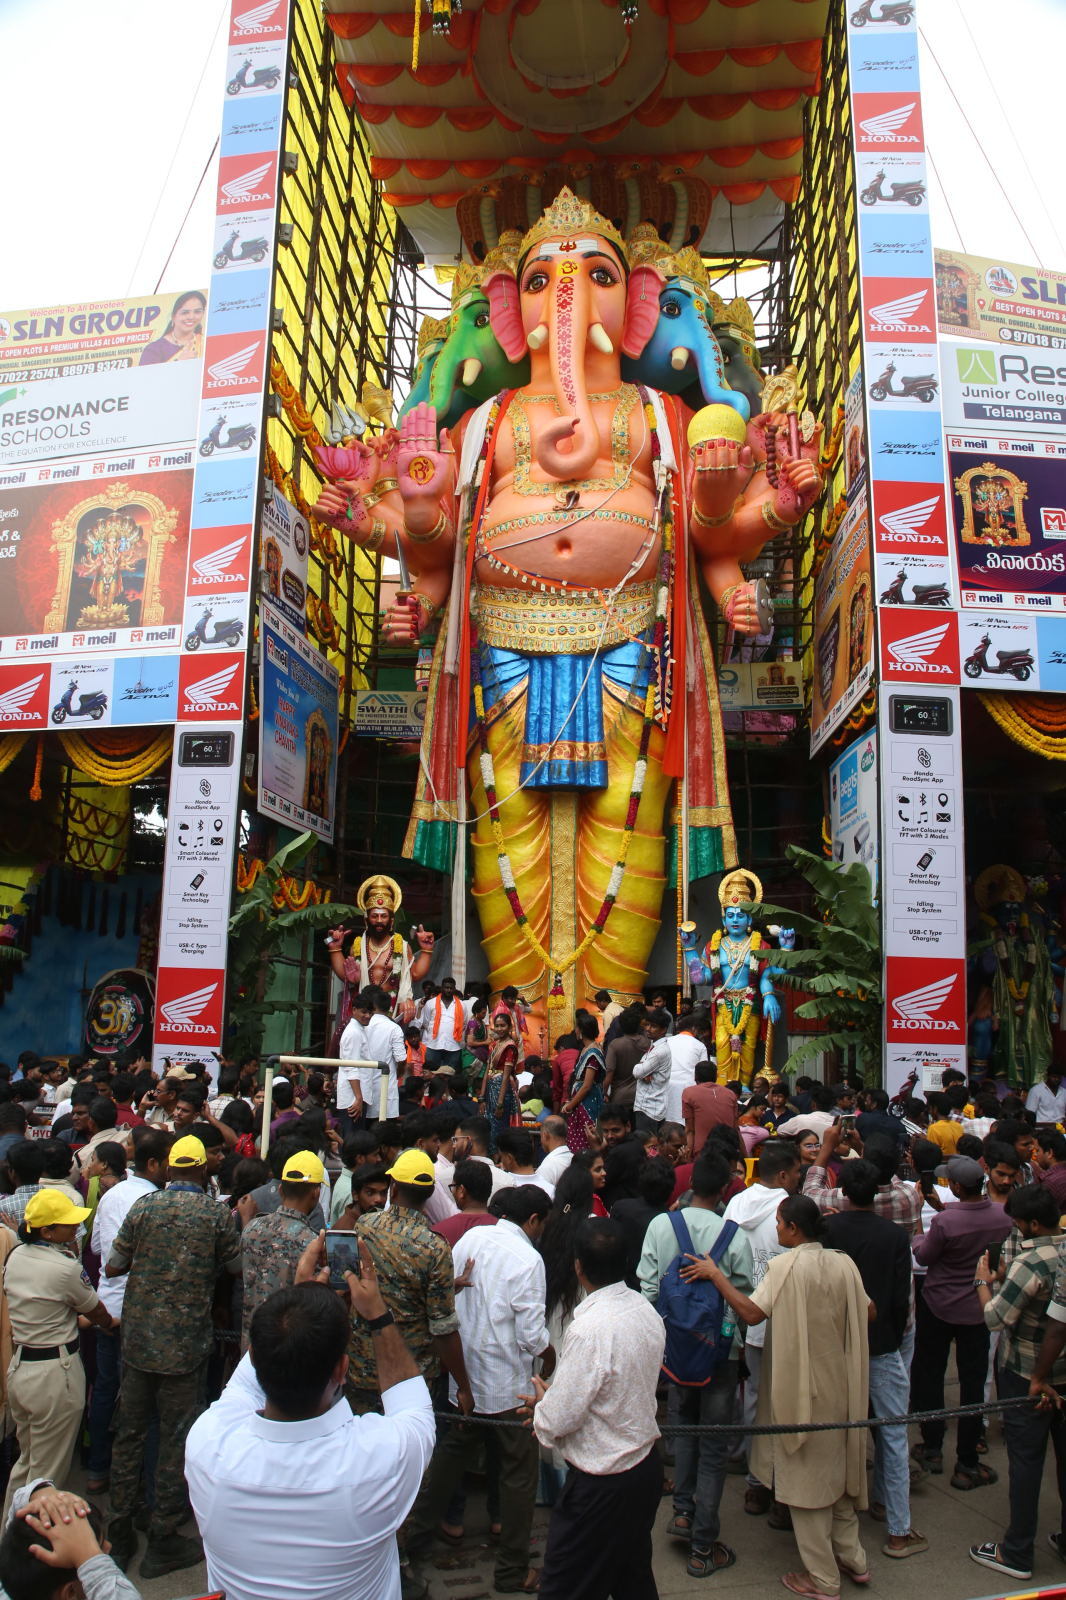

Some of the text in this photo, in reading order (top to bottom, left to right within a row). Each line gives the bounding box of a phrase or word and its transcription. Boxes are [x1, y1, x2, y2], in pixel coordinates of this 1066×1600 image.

[232, 25, 283, 37] HONDA
[860, 135, 920, 143] HONDA
[219, 193, 272, 206] HONDA
[30, 308, 64, 317] Welcome
[90, 301, 126, 310] Devotees
[995, 302, 1014, 312] BEST
[1016, 305, 1036, 317] OPEN
[1037, 309, 1058, 321] PLOTS
[13, 306, 160, 341] SLN GROUP
[869, 324, 932, 333] HONDA
[6, 348, 23, 357] OPEN
[23, 345, 43, 355] PLOTS
[50, 342, 79, 352] PREMIUM
[80, 338, 103, 348] VILLAS
[112, 335, 127, 345] LOW
[128, 333, 150, 343] PRICES
[1013, 332, 1048, 346] 97018
[63, 362, 95, 377] 88979
[96, 358, 129, 373] 93274
[207, 375, 259, 388] HONDA
[962, 386, 1010, 400] Junior
[2, 397, 129, 427] RESONANCE
[982, 405, 1062, 421] Telangana
[1, 421, 91, 448] SCHOOLS
[1, 436, 129, 459] THE EQUATION FOR EXCELLENCE
[964, 440, 1035, 452] meil meil
[0, 453, 192, 484] meil meil meil meil
[264, 503, 291, 533] SWATHI
[880, 533, 944, 544] HONDA
[191, 573, 247, 585] HONDA
[979, 594, 1051, 606] meil meil
[30, 628, 176, 650] meil meil meil
[888, 661, 953, 674] HONDA
[183, 702, 240, 713] HONDA
[357, 705, 407, 713] SWATHI
[917, 711, 928, 720] 60
[203, 745, 213, 753] 60
[908, 879, 941, 887] Technology
[907, 907, 920, 915] Stop
[916, 901, 934, 909] Idling
[911, 936, 940, 944] Charging
[928, 930, 943, 938] Type
[180, 948, 204, 956] Charging
[159, 1022, 216, 1034] HONDA
[892, 1019, 960, 1030] HONDA
